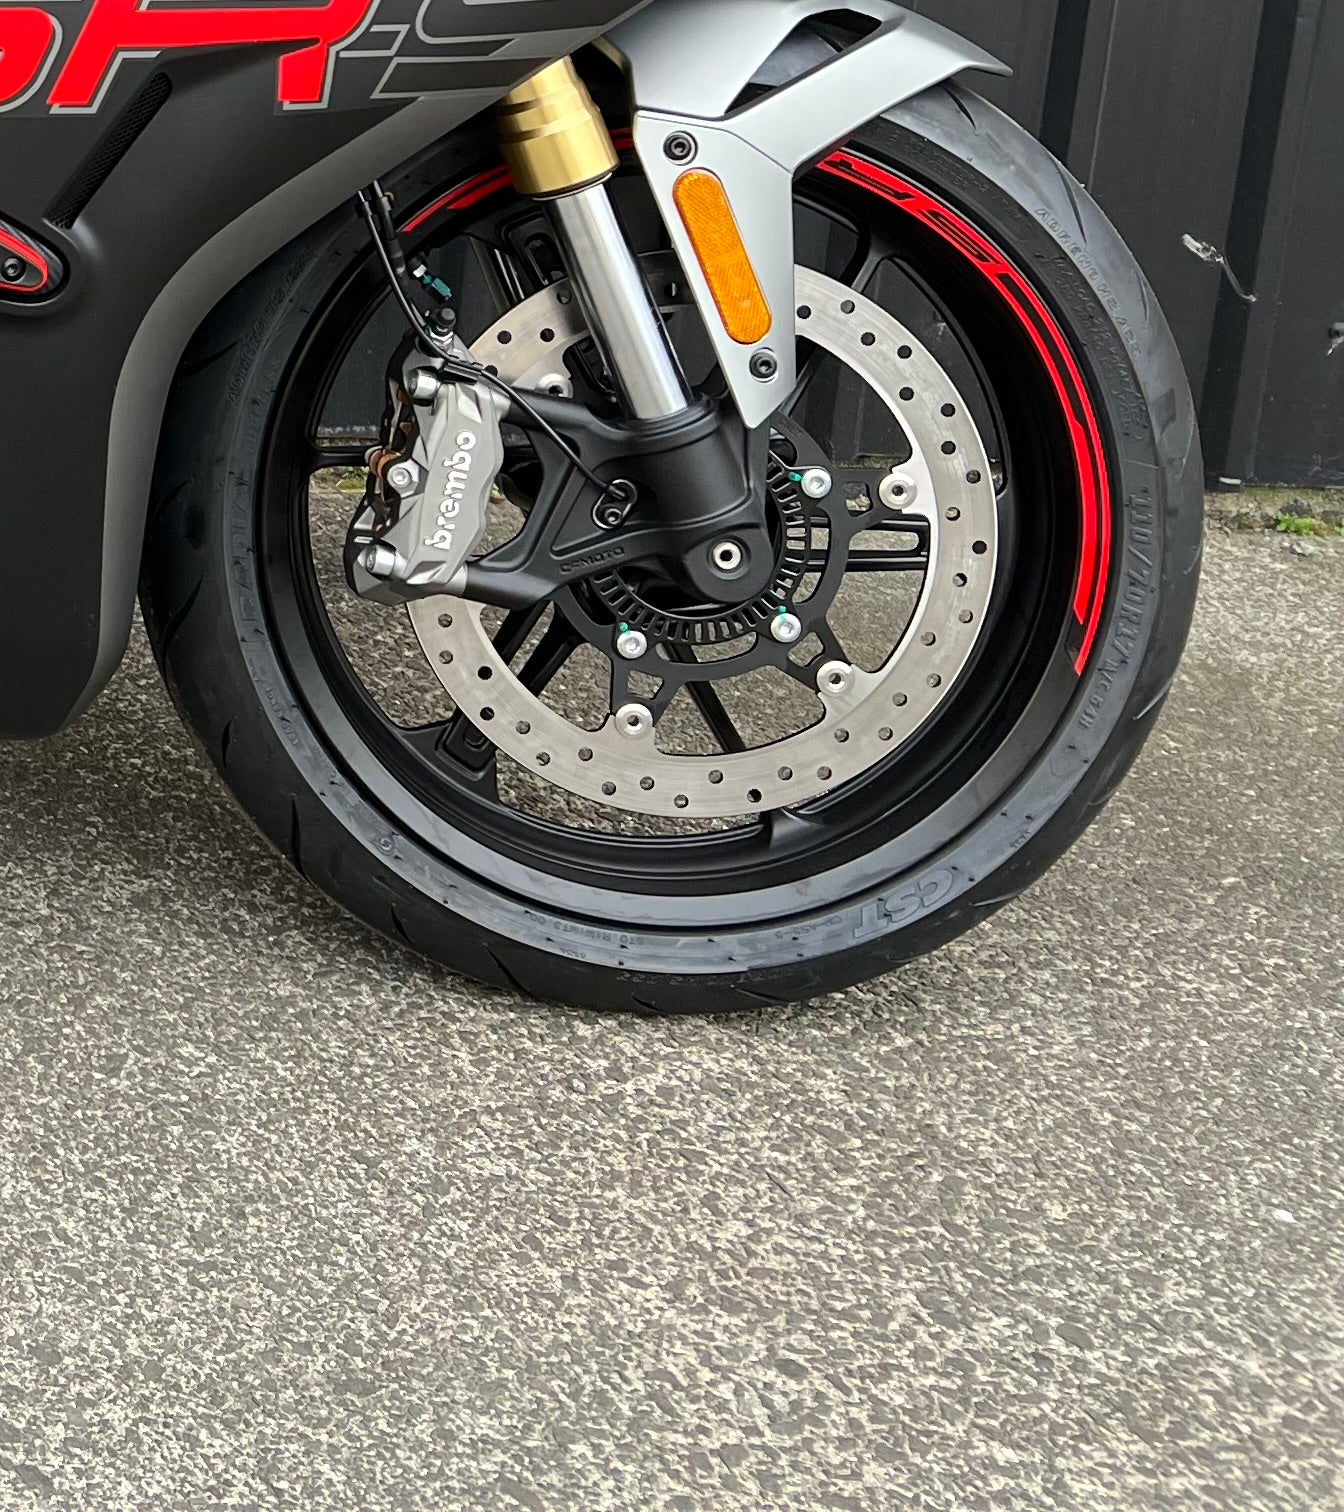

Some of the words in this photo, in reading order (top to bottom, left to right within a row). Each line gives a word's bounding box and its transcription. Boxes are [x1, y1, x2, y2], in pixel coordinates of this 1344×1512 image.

[424, 431, 477, 550] brembo
[560, 545, 625, 572] CFMOTO
[840, 863, 961, 941] CST
